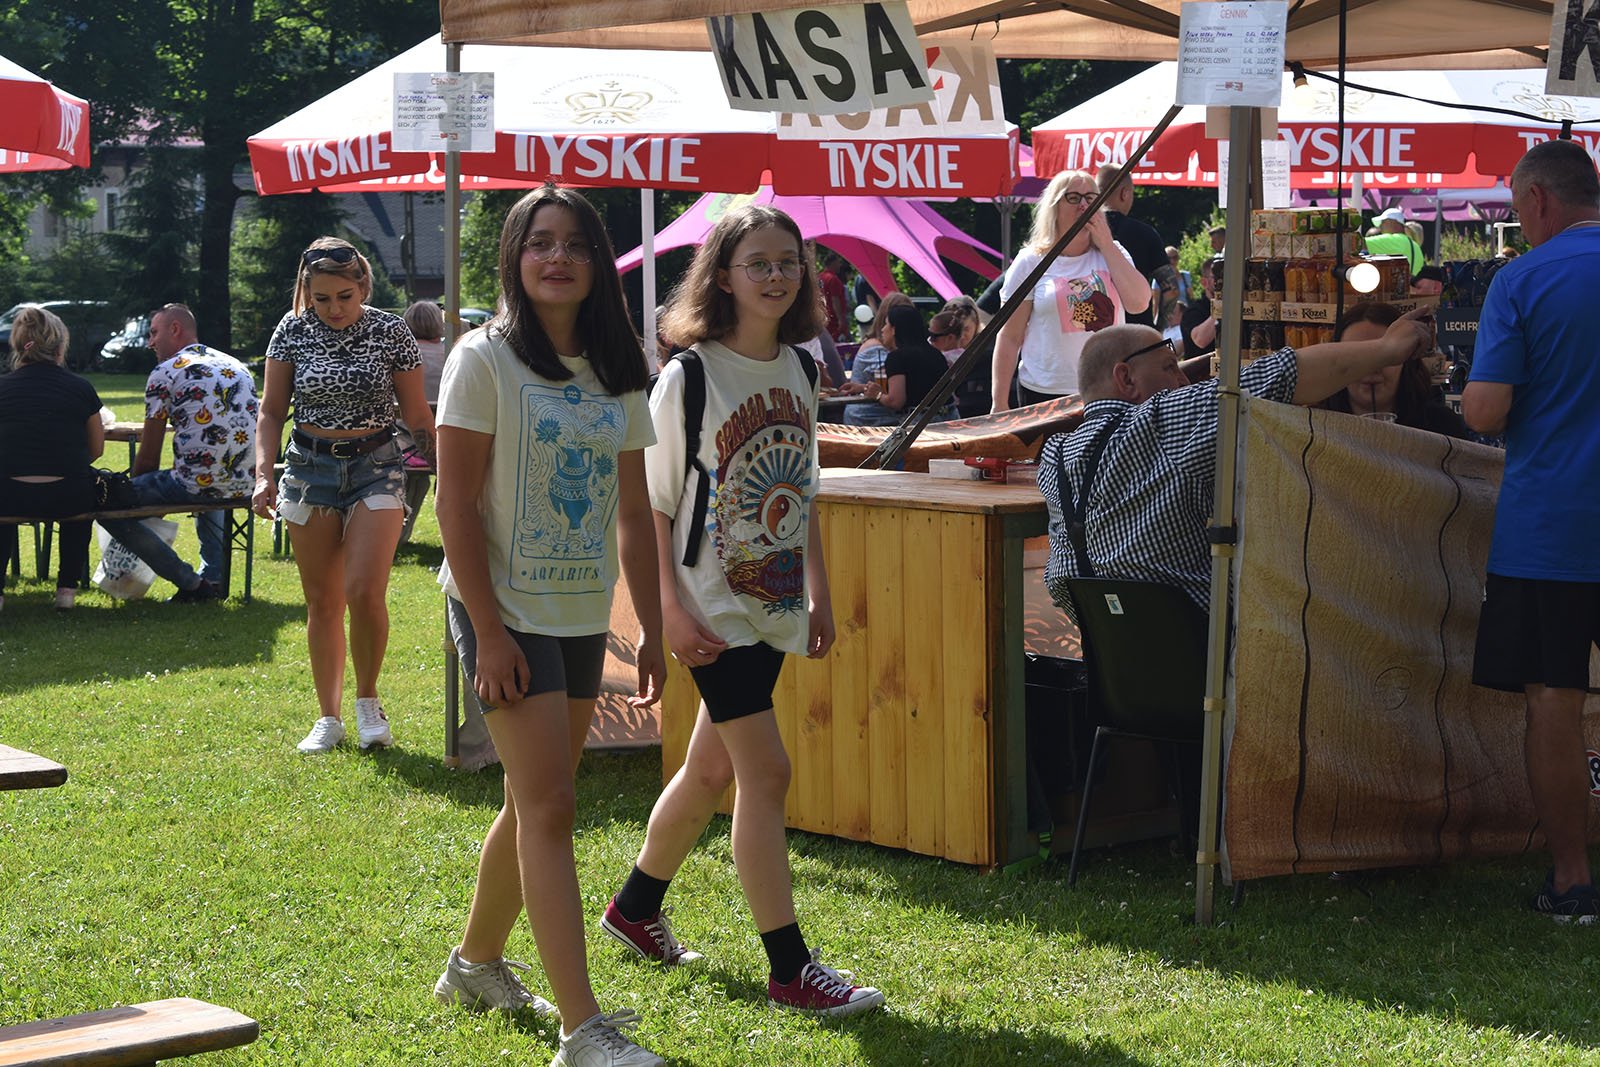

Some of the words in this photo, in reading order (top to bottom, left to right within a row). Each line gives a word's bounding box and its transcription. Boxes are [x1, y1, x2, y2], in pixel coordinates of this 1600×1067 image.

[1220, 9, 1249, 19] CENNIK
[710, 2, 926, 102] KASA
[282, 131, 391, 183] TYSKIE
[514, 133, 701, 184] TYSKIE
[819, 142, 963, 189] TYSKIE
[1279, 127, 1416, 168] YSKIE
[1302, 308, 1327, 319] Kozel
[1445, 321, 1466, 331] LECH
[1467, 322, 1479, 331] FR
[715, 393, 767, 467] SPREAD
[529, 566, 600, 581] AQUARIUS
